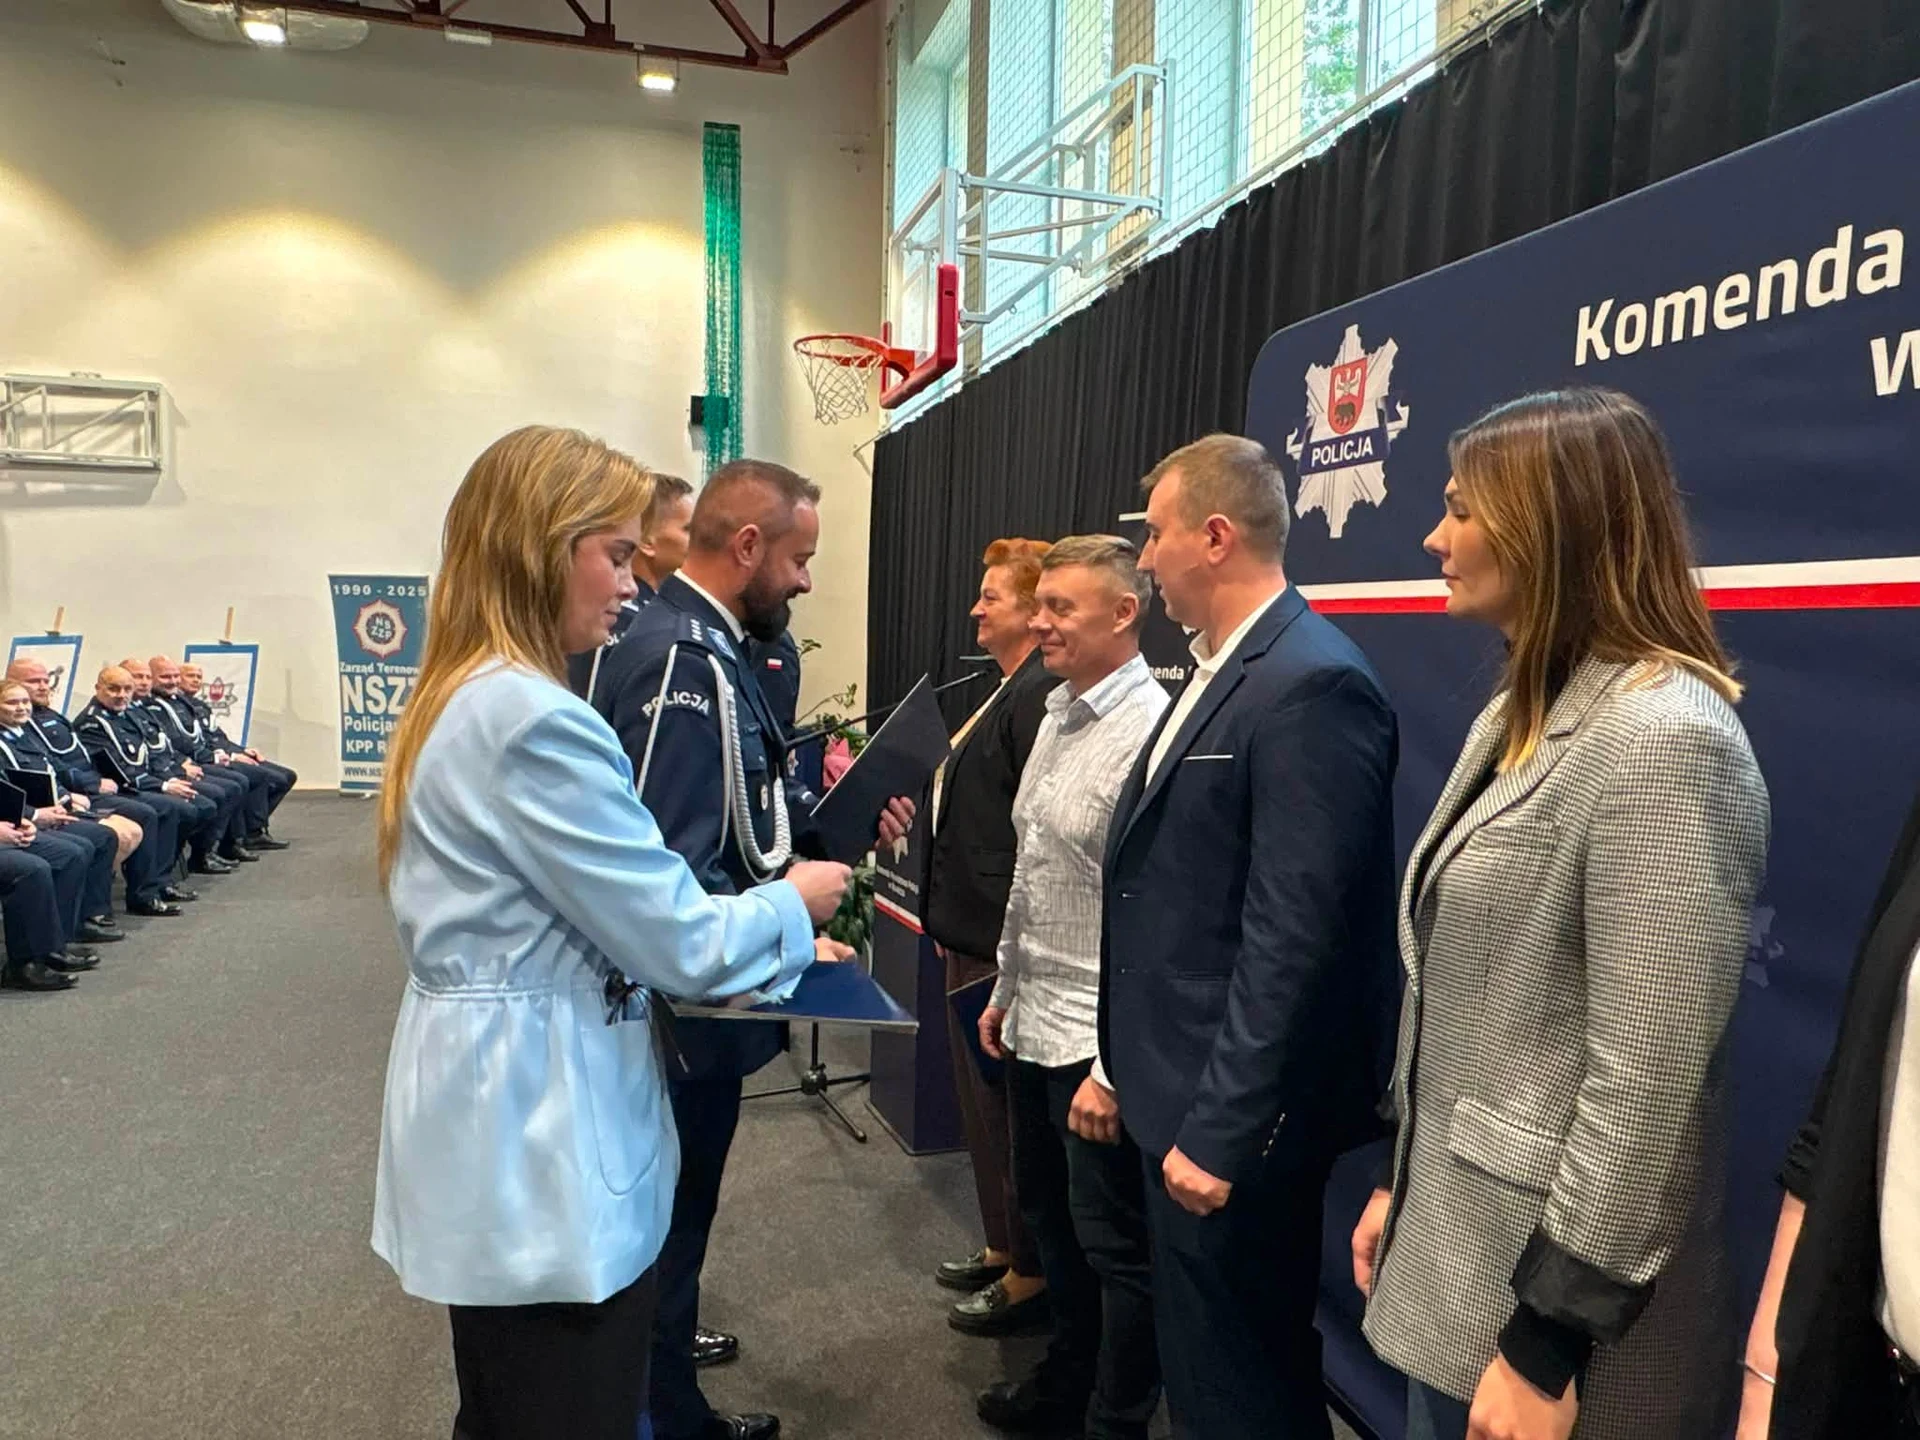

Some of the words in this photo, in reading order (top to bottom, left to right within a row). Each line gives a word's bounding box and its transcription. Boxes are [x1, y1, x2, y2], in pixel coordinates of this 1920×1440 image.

[1574, 224, 1904, 366] Komenda
[1311, 436, 1373, 468] POLICJA
[333, 584, 372, 596] 1990
[387, 585, 428, 597] 2025
[340, 661, 375, 676] Zarząd
[376, 662, 420, 674] Terenow
[346, 739, 374, 753] KPP
